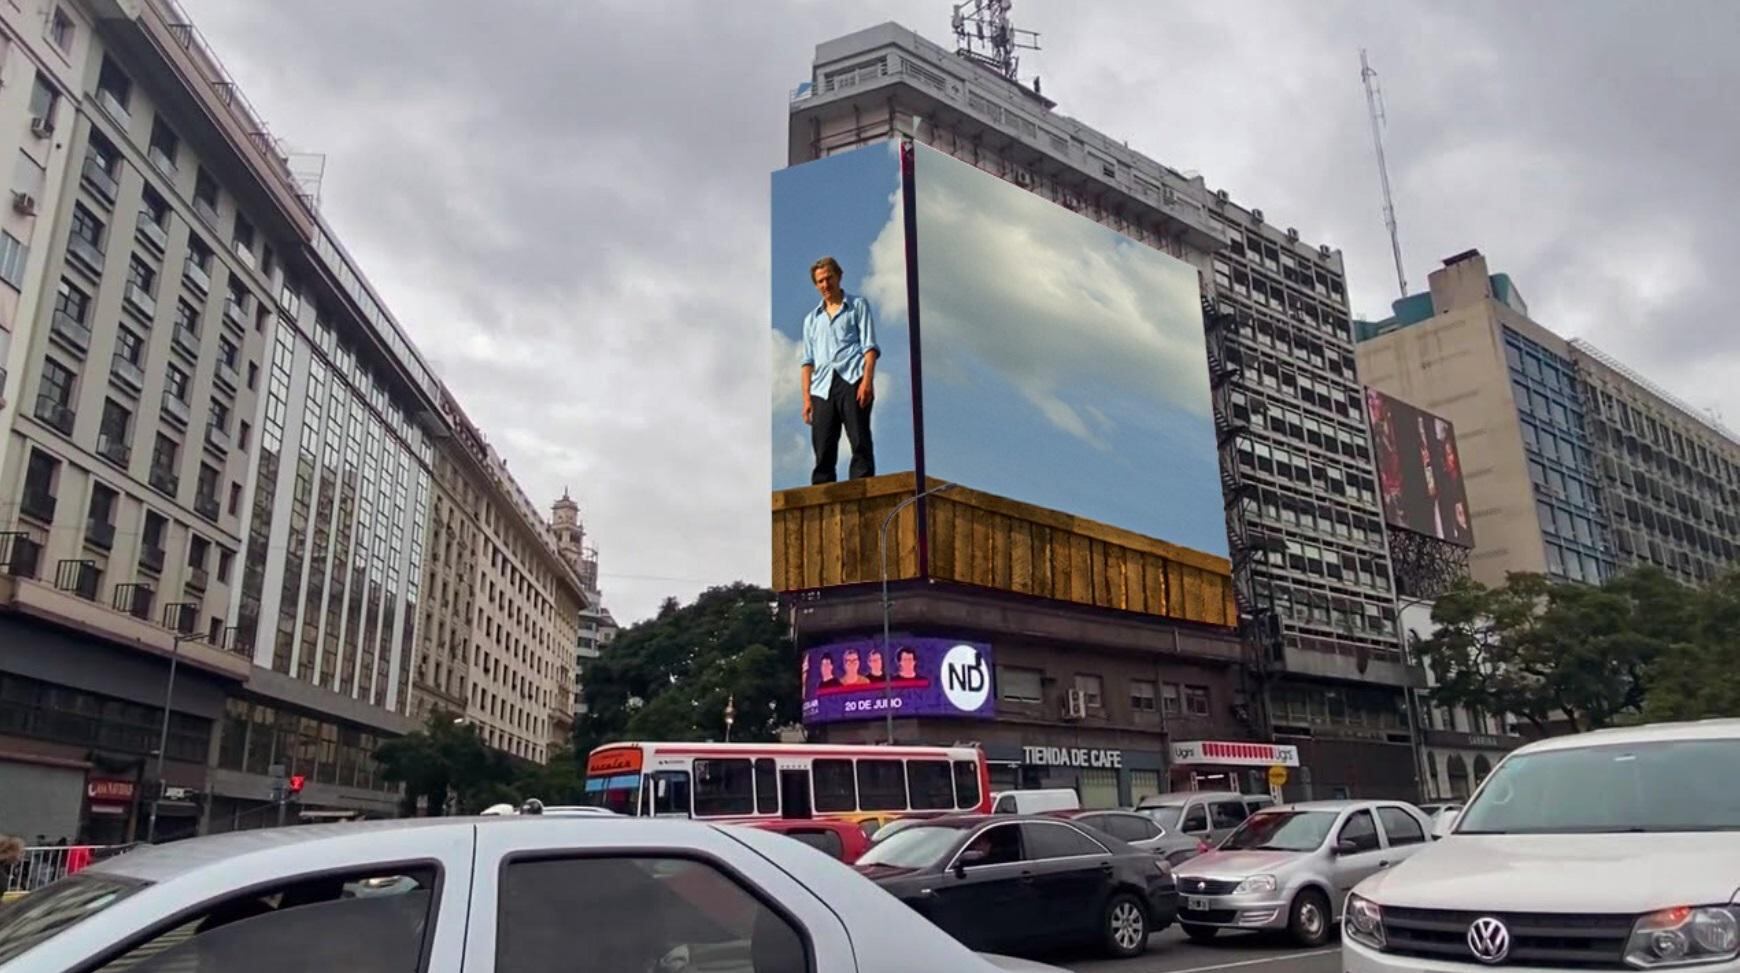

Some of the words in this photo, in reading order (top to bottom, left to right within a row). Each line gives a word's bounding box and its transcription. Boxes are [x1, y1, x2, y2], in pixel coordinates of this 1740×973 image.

[948, 656, 986, 692] ND
[844, 700, 857, 711] 20
[858, 699, 872, 711] DE
[1023, 746, 1070, 766] TIENDA
[1070, 748, 1089, 766] DE
[1091, 749, 1123, 768] CAFE
